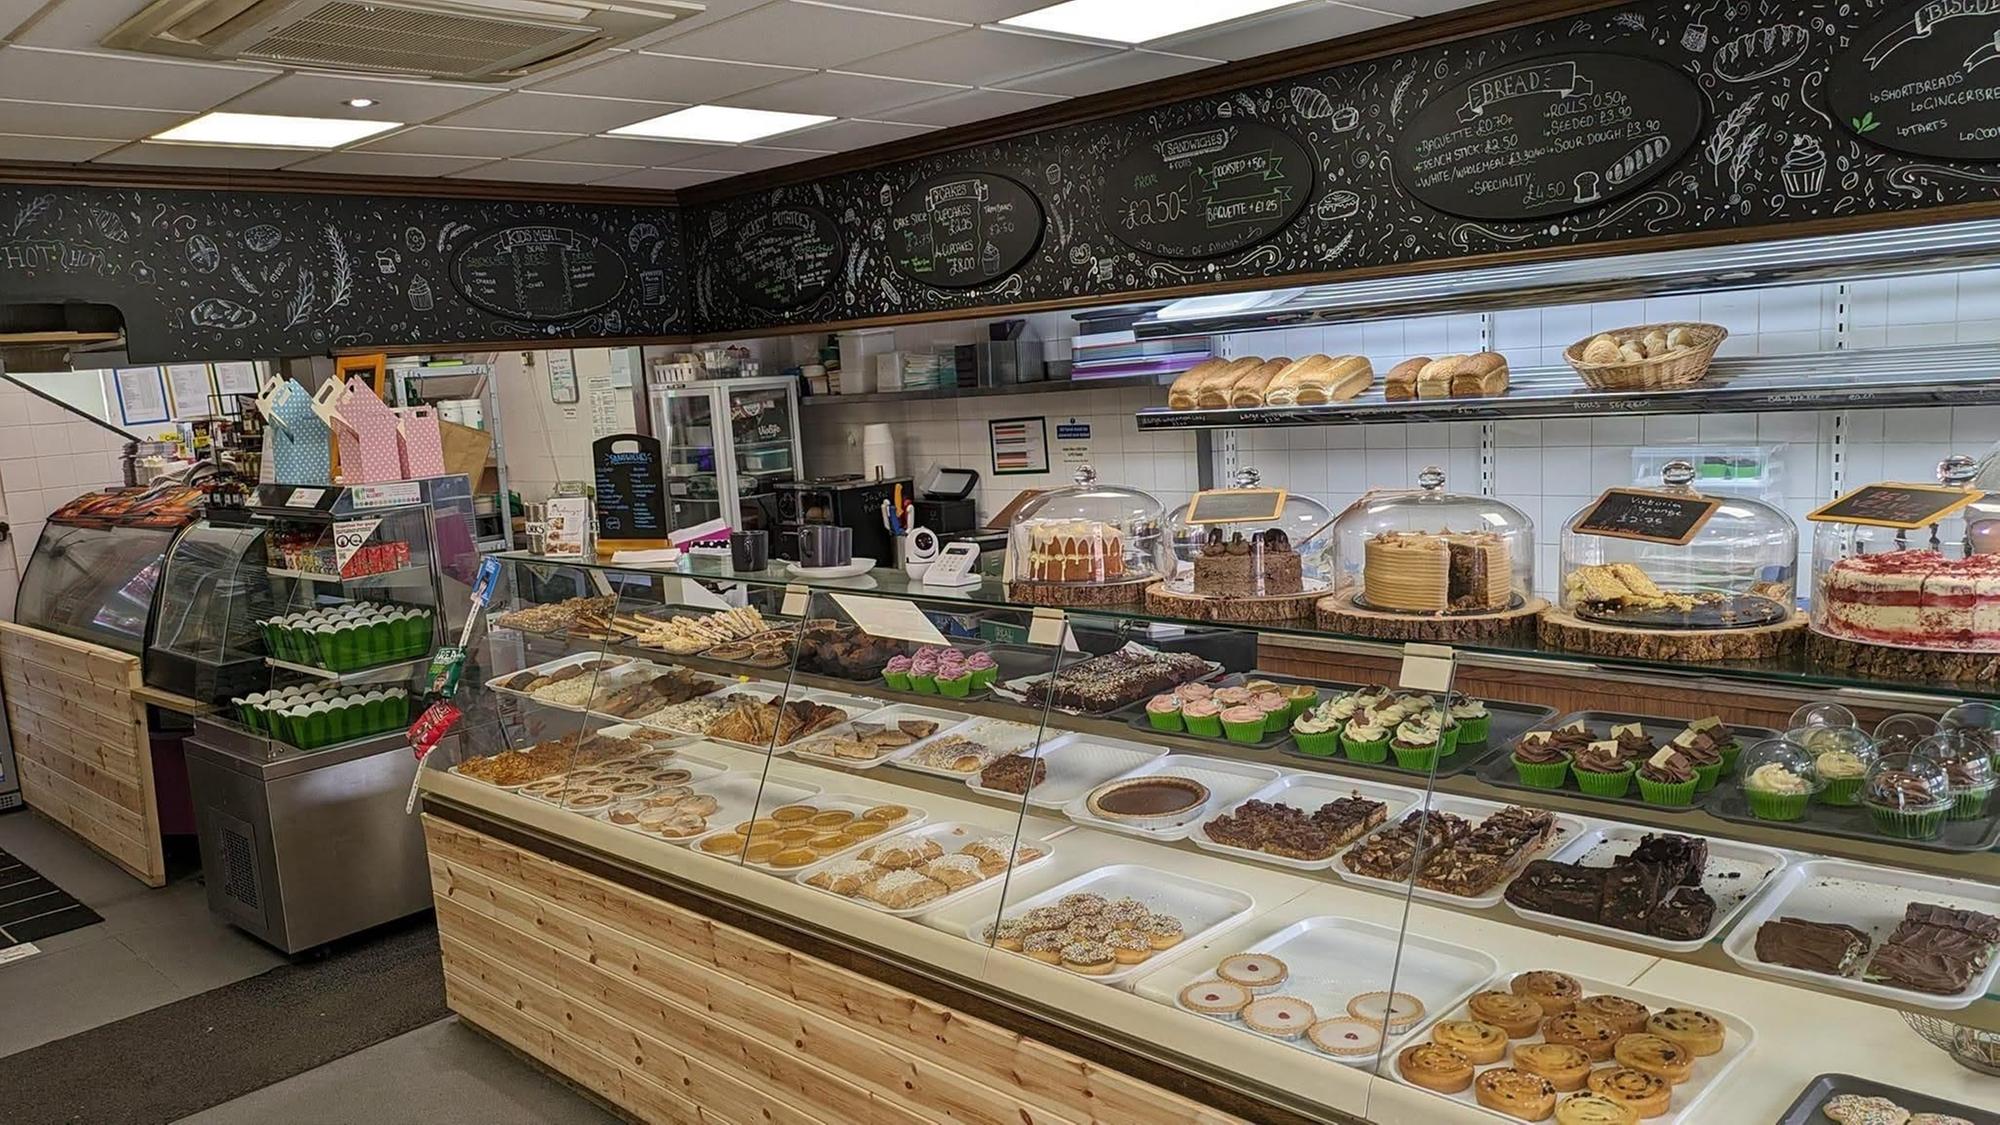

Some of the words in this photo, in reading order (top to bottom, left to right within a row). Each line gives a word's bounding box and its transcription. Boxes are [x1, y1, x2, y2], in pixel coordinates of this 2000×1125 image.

[1482, 71, 1541, 103] BREAD
[1880, 71, 1964, 101] SHORTBREADS
[1907, 119, 1948, 136] TARTS
[1974, 127, 2000, 141] COO
[1167, 133, 1223, 155] SANDWICHES
[1554, 137, 1585, 154] SOUR
[1419, 152, 1452, 171] FRENCH
[1, 243, 57, 269] HOT
